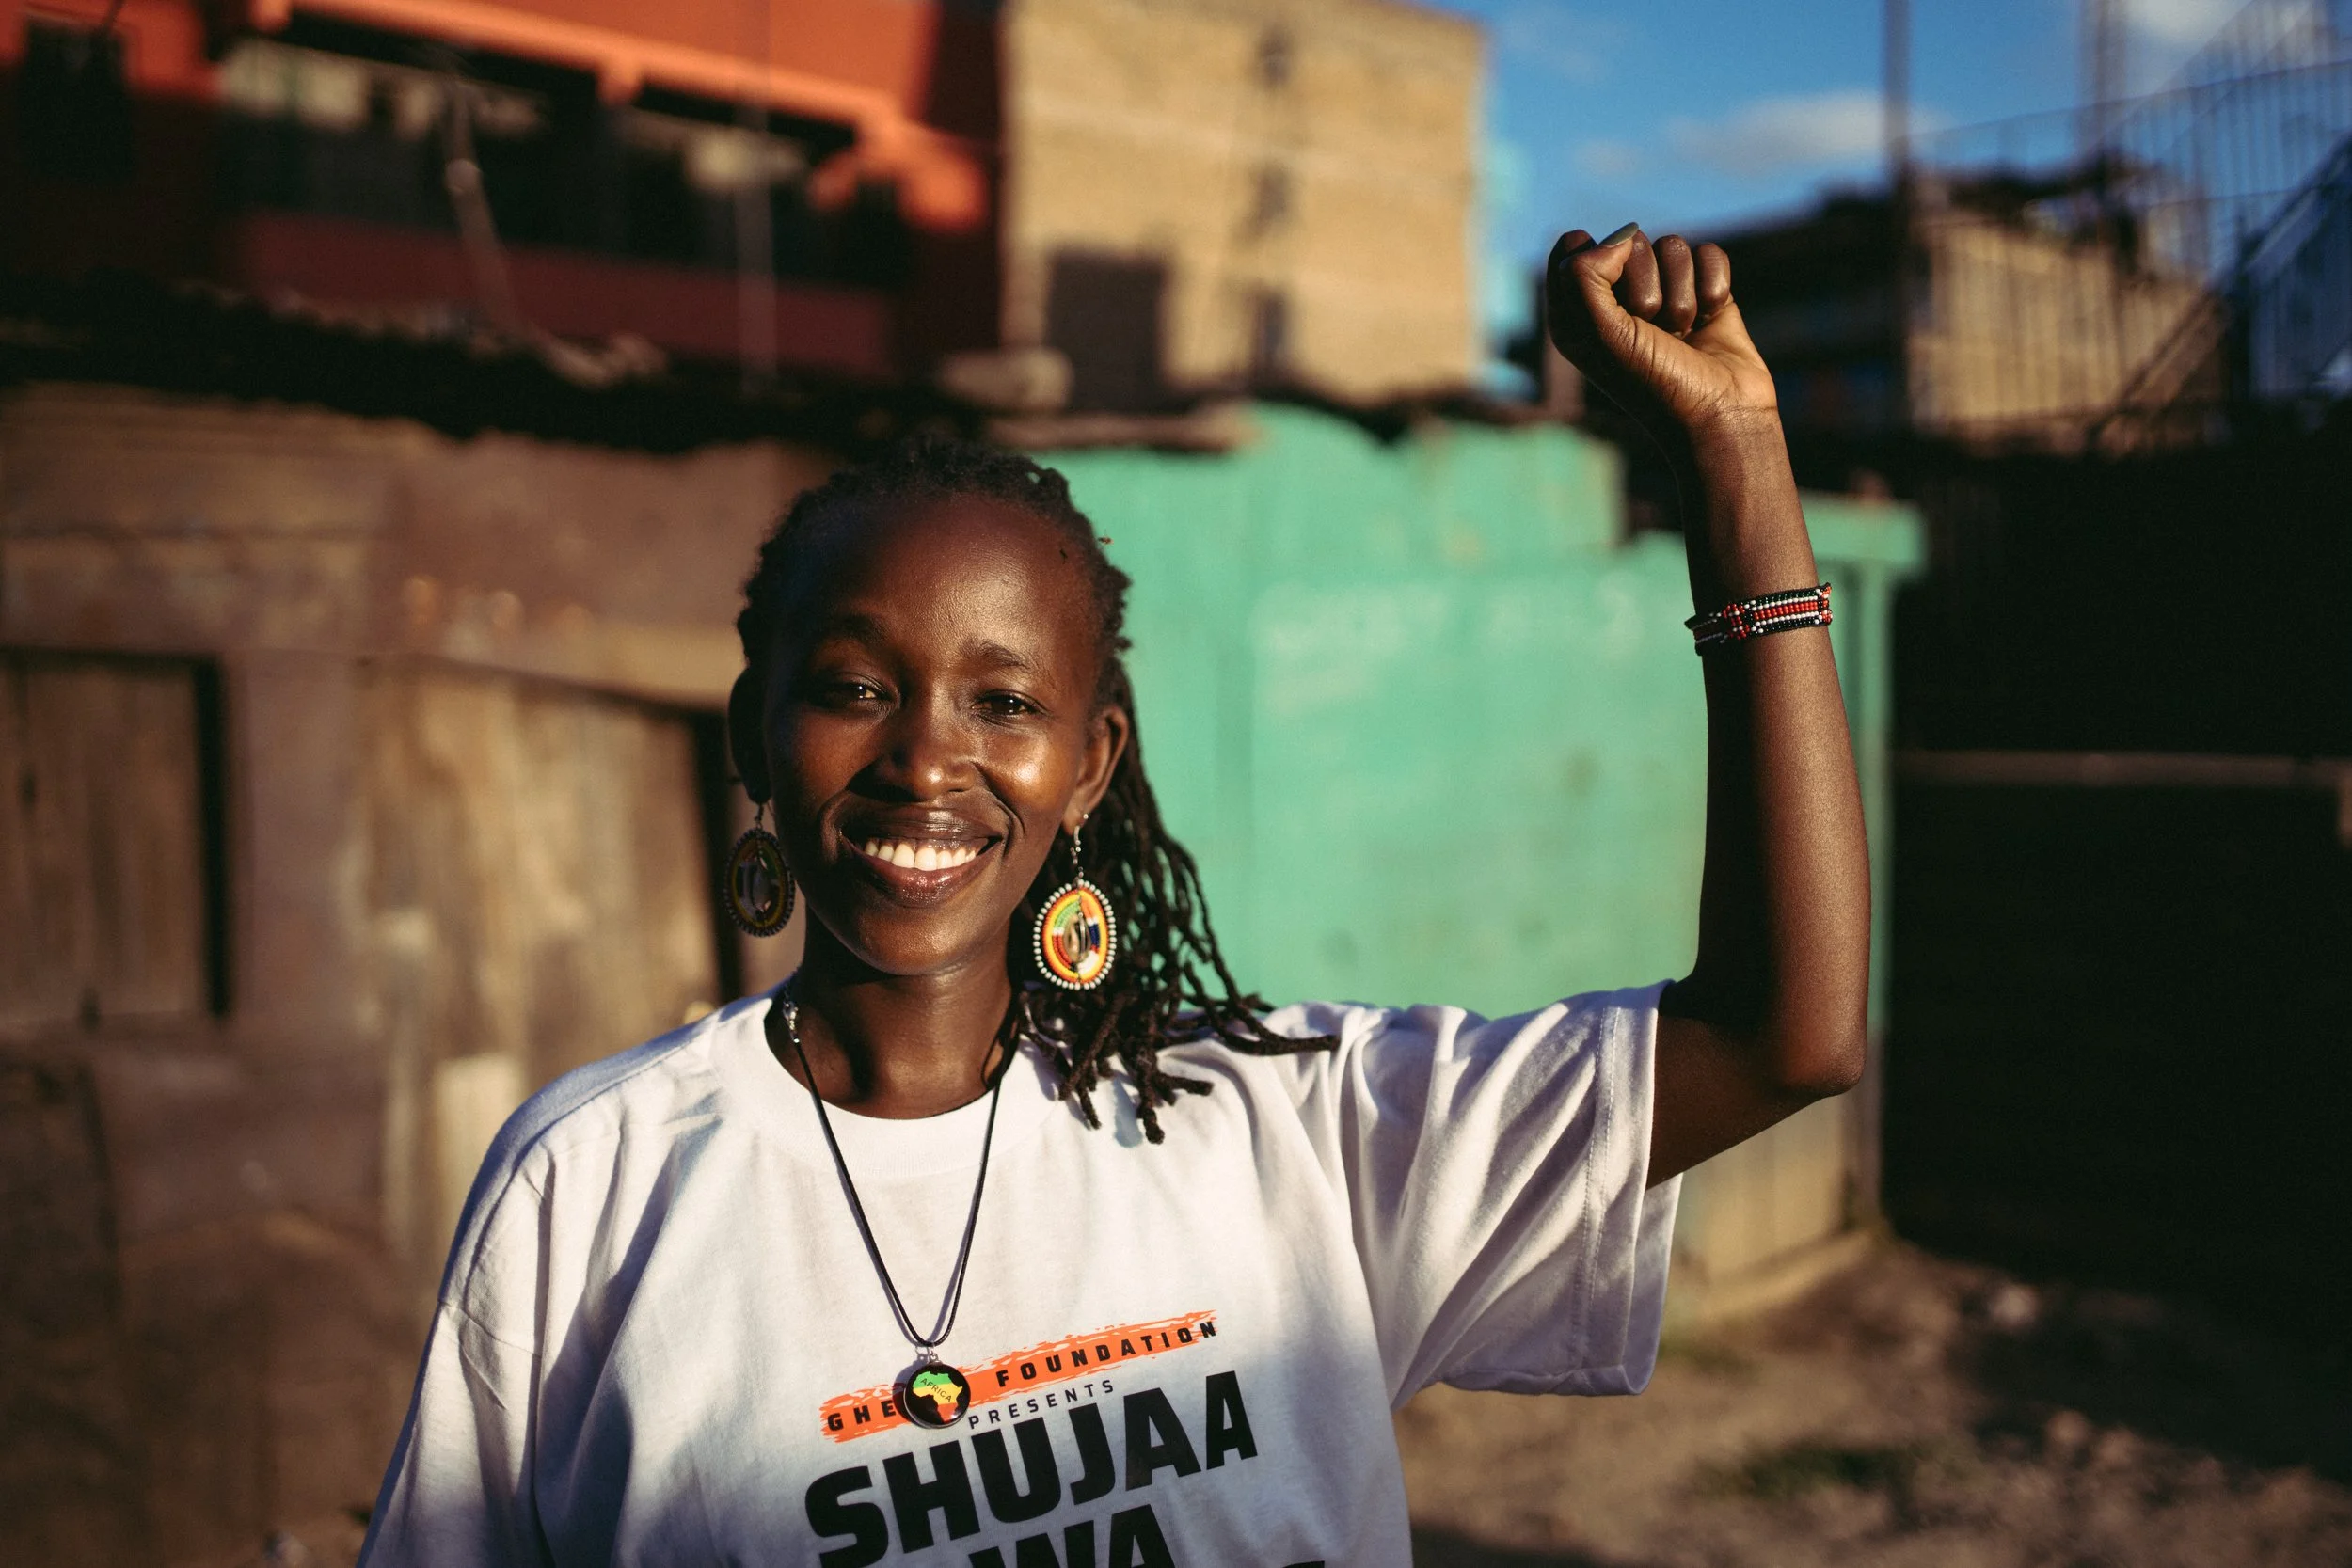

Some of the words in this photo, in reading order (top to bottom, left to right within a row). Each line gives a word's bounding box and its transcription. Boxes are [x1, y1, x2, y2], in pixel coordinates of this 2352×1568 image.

[827, 1399, 897, 1432] GHE
[995, 1321, 1216, 1387] FOUNDATION
[920, 1378, 952, 1402] AFRICA
[968, 1379, 1114, 1430] PRESENTS
[804, 1370, 1258, 1568] SHUJAA
